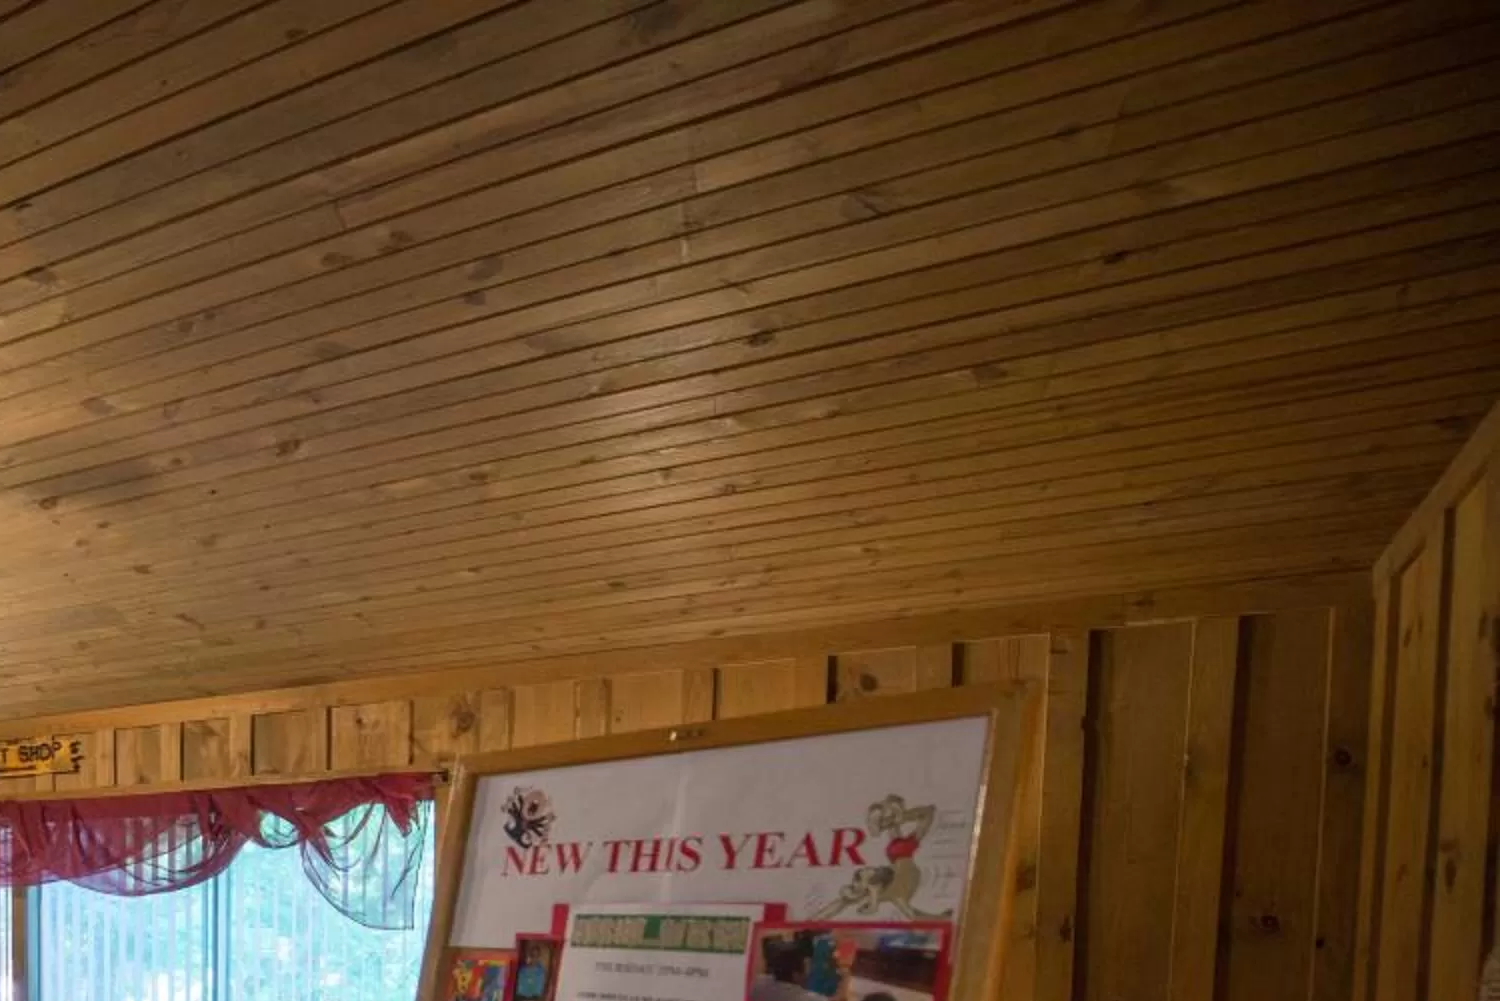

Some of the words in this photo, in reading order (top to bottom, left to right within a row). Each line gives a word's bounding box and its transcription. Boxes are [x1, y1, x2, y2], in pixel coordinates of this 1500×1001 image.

[18, 741, 63, 763] SHOP
[501, 841, 592, 877] NEW
[604, 834, 704, 876] THIS
[717, 827, 867, 871] YEAR
